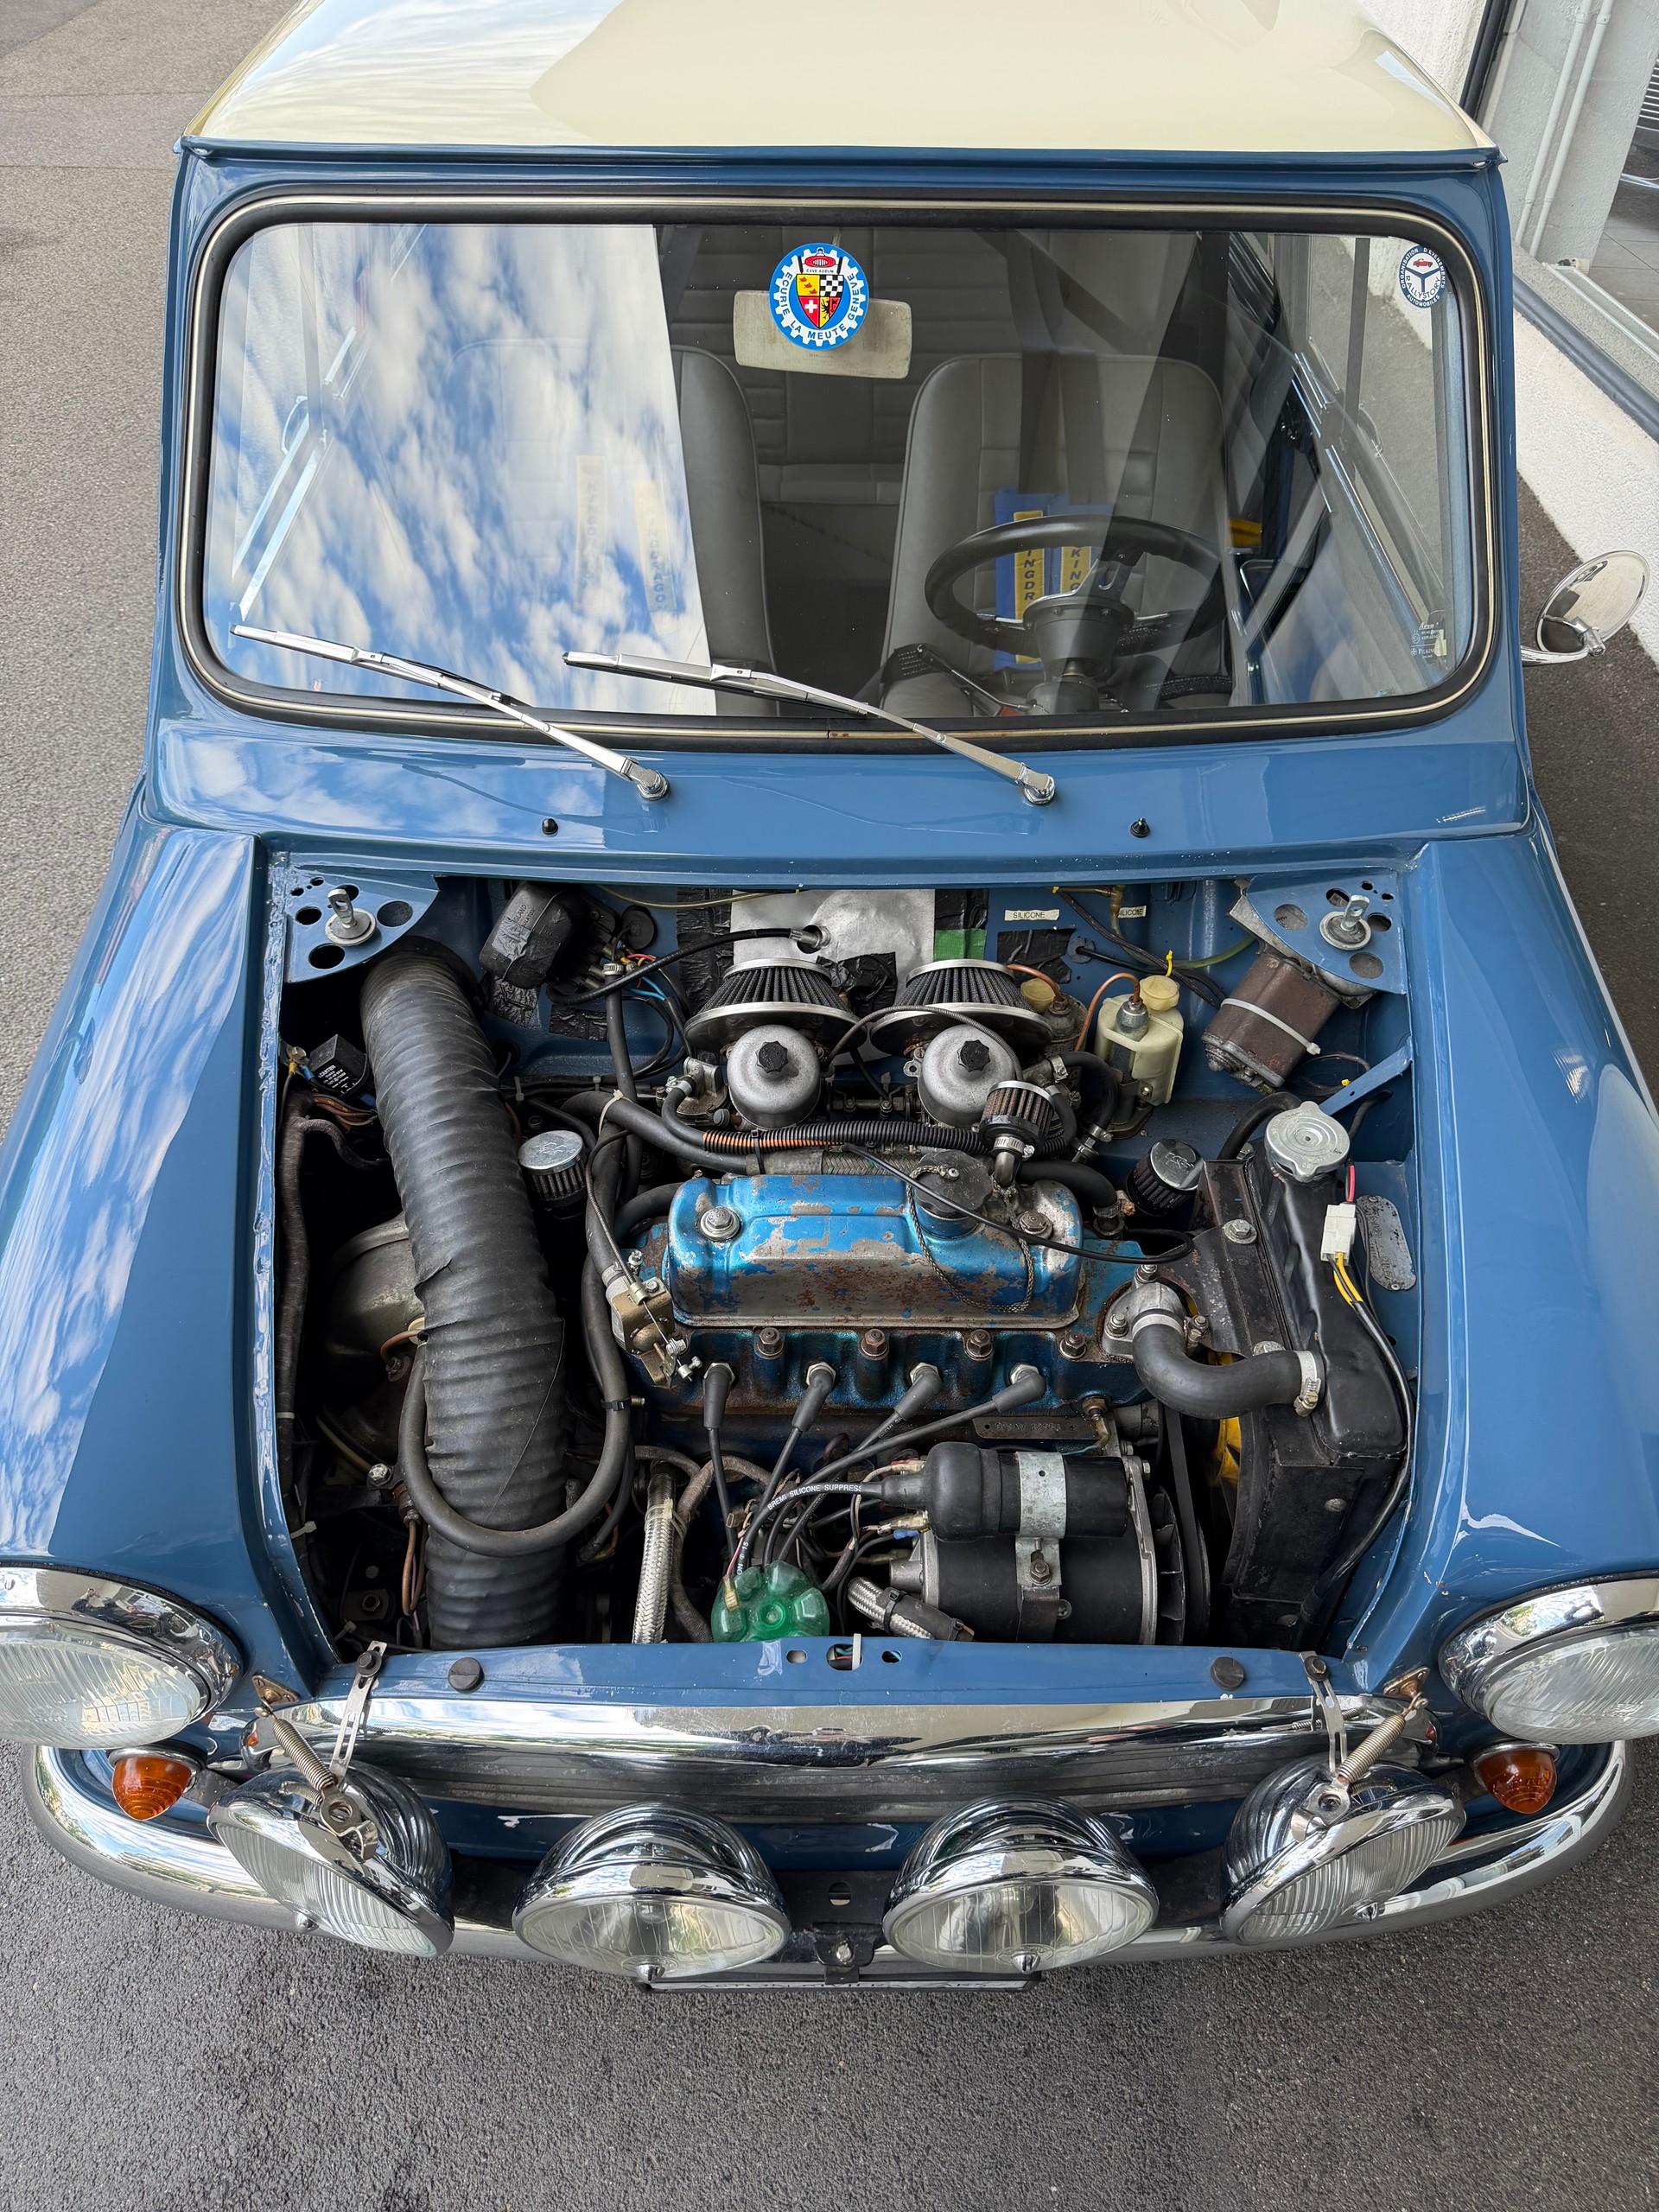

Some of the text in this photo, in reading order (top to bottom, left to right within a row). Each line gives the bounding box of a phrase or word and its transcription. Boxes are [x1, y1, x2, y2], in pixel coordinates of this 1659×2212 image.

[1405, 275, 1440, 299] RALLYSTORY
[779, 271, 860, 340] ECURIE LA MEUTE GENEVE
[1406, 295, 1440, 307] AUTOMOBILES
[766, 1495, 787, 1510] BREMI
[789, 1484, 821, 1497] SILICONE
[736, 1541, 749, 1575] ON 15
